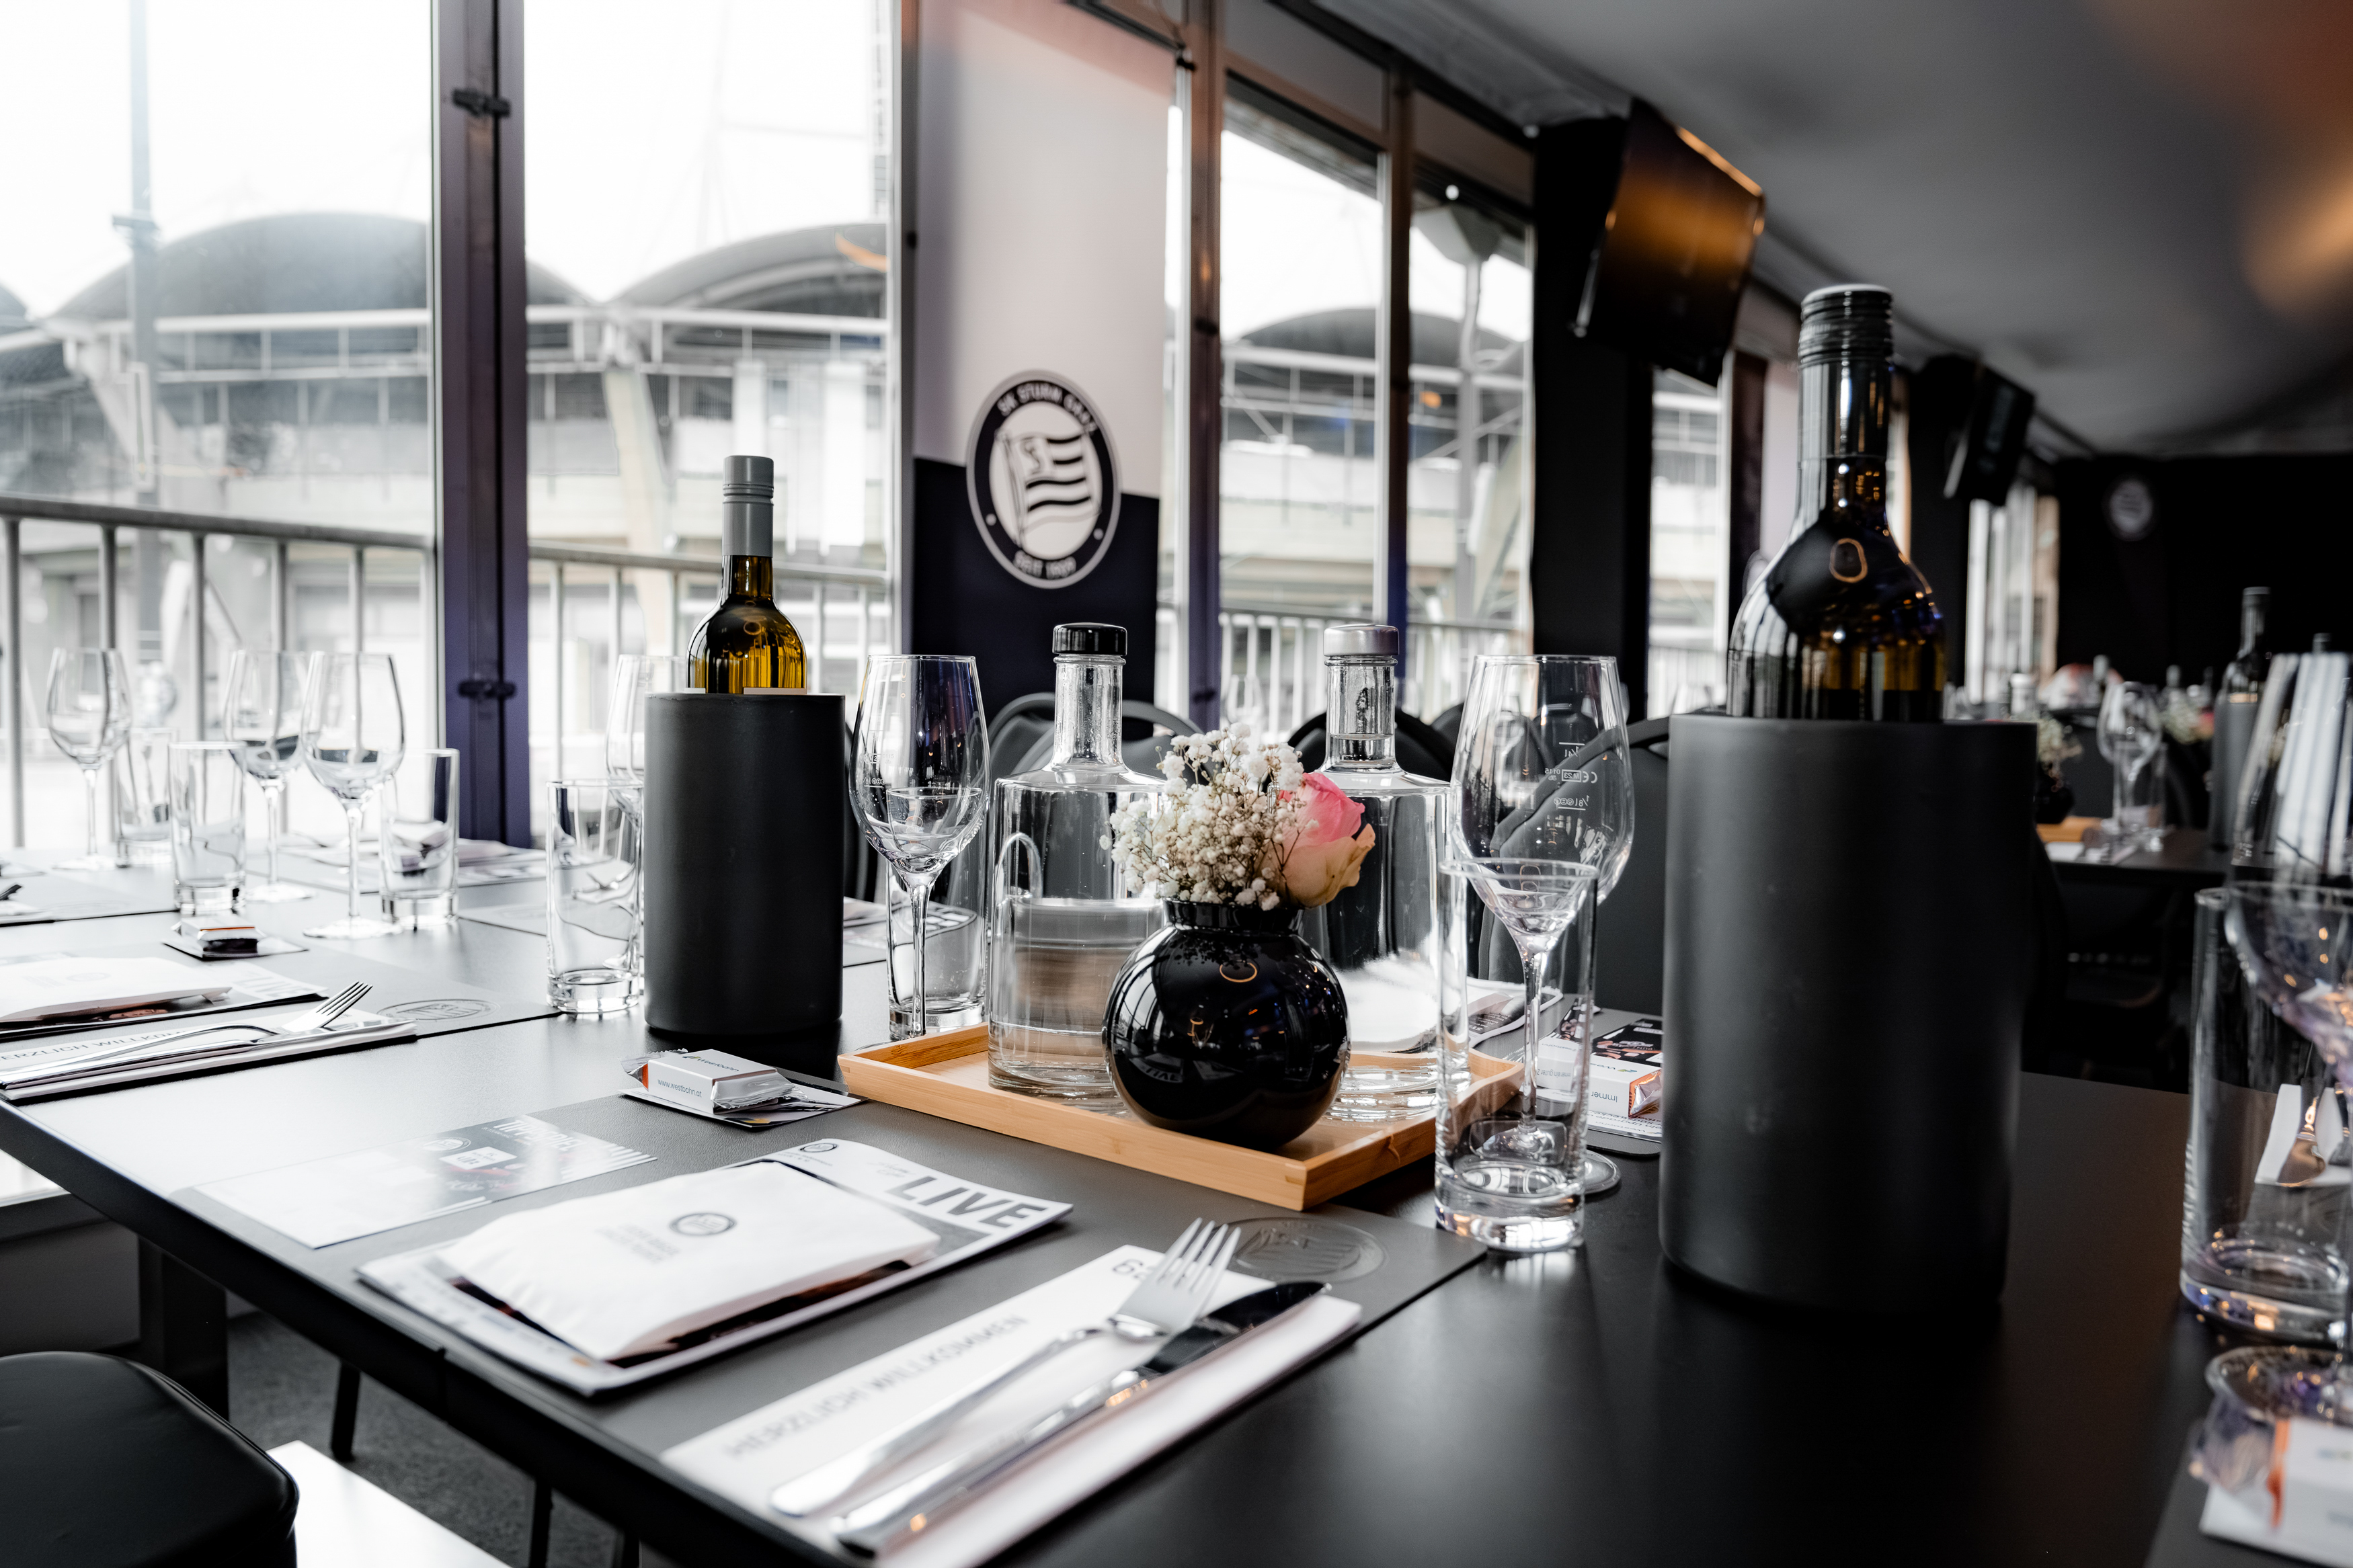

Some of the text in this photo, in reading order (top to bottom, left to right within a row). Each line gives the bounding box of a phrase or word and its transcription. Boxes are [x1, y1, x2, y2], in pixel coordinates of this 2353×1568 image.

[0, 1044, 89, 1062] ERZLICH
[697, 1057, 740, 1072] Westbahn
[657, 1078, 703, 1098] www.westbahn.at
[1591, 1091, 1618, 1103] Immer
[884, 1176, 1048, 1228] LIVE
[725, 1314, 1029, 1459] HERZLICH WILLKOMMEN
